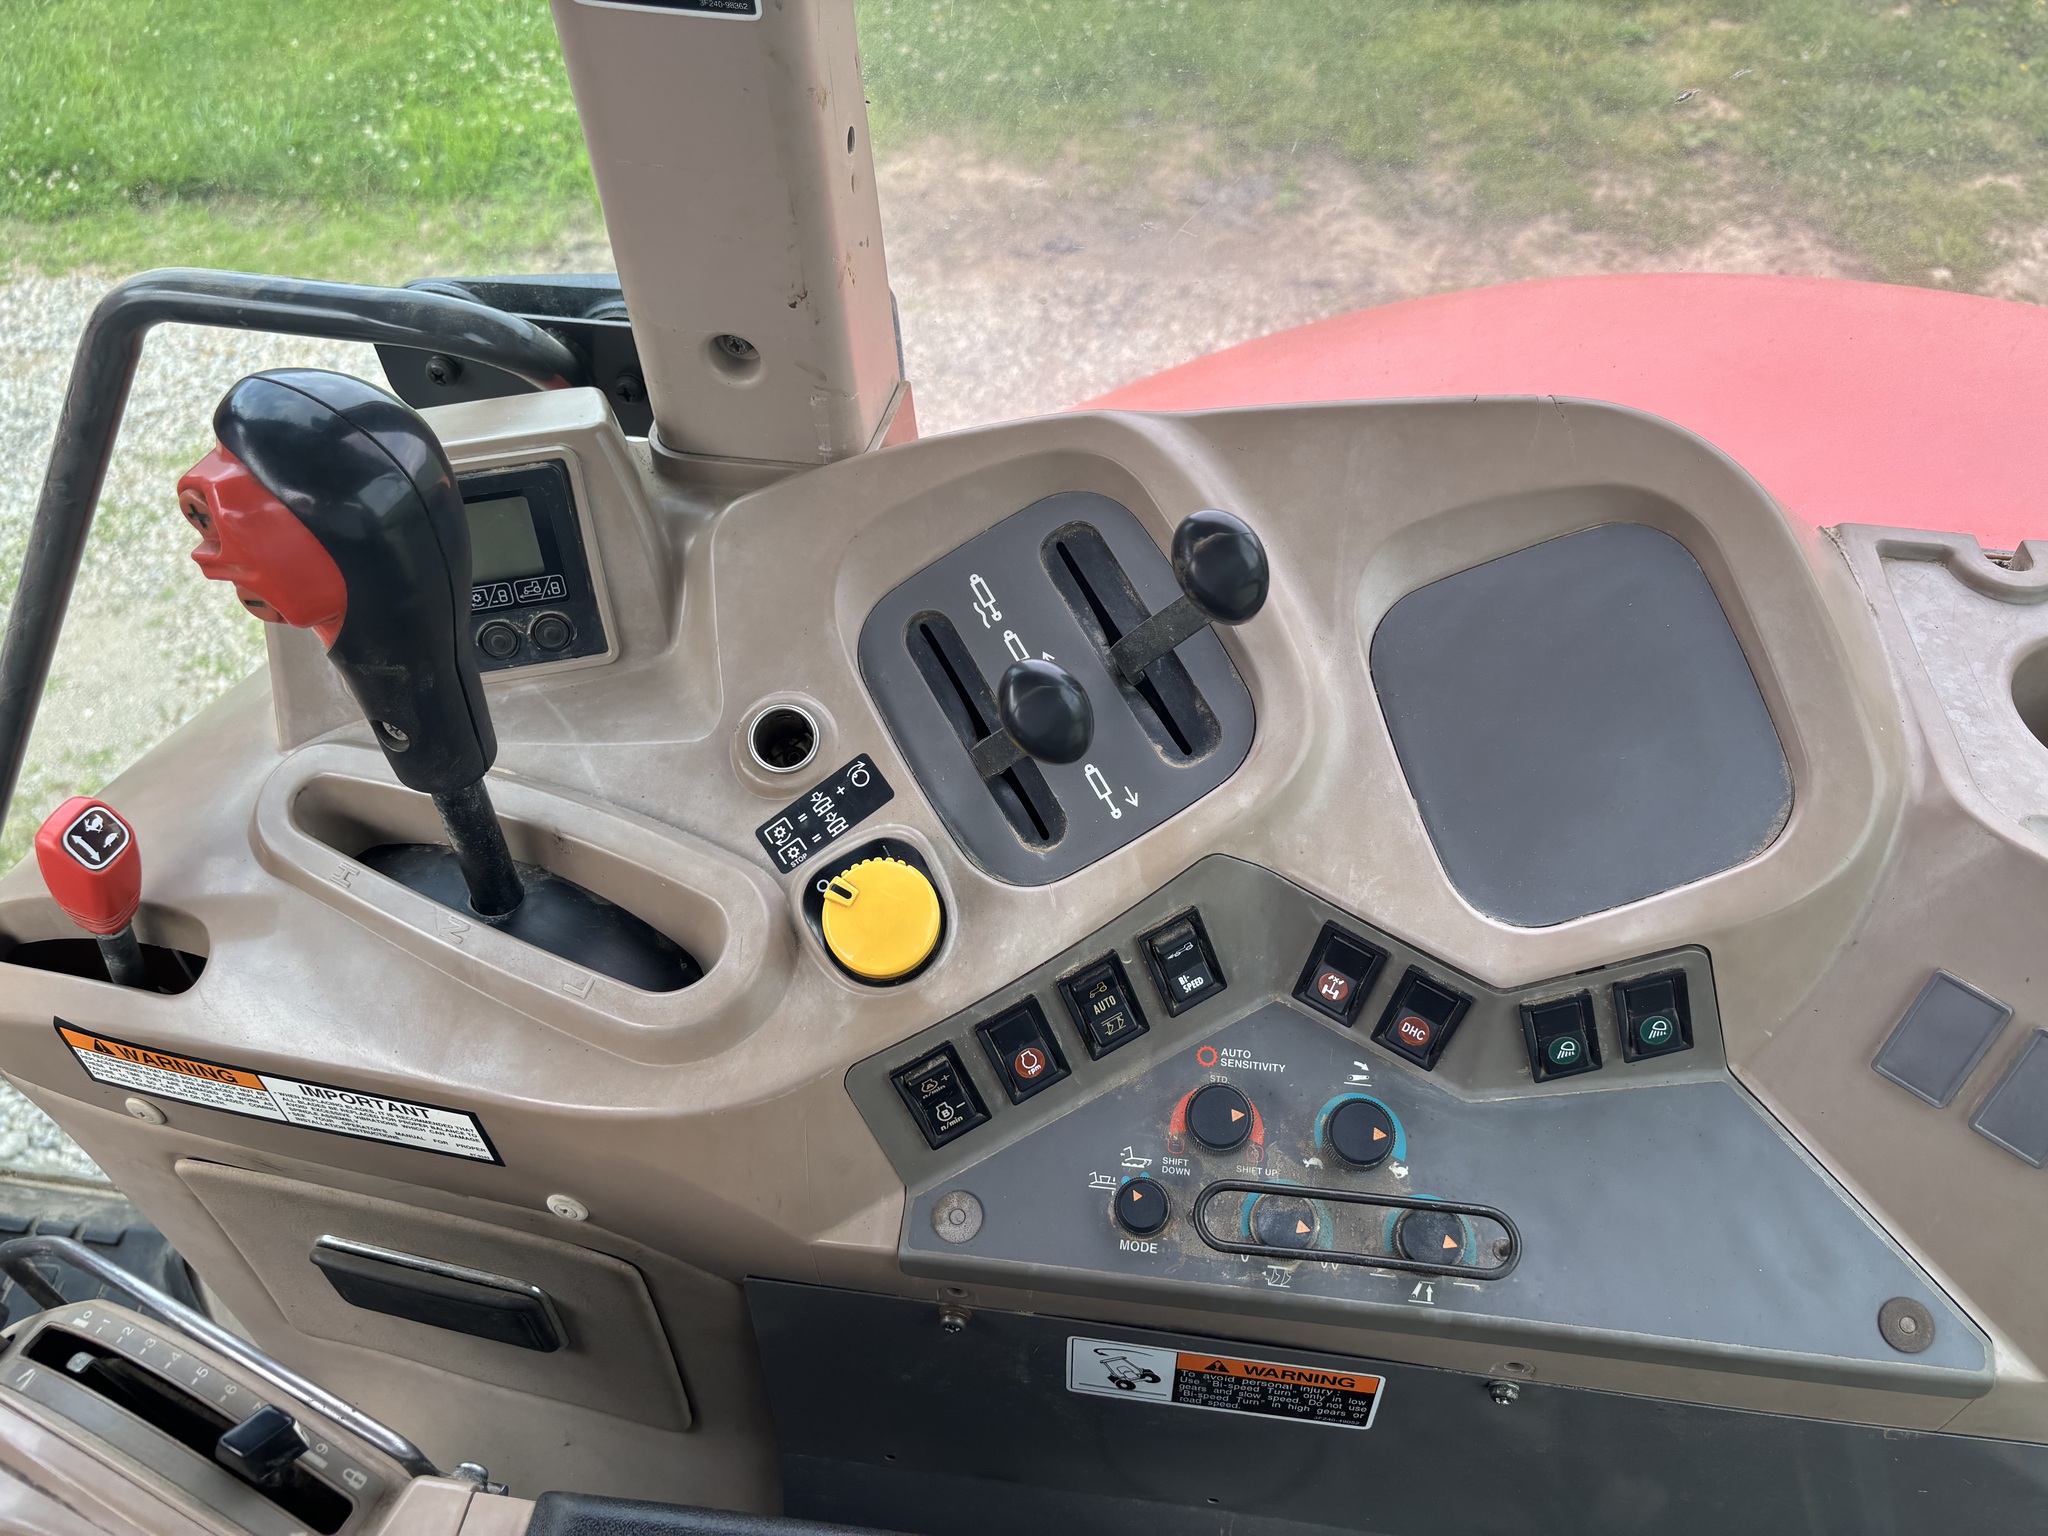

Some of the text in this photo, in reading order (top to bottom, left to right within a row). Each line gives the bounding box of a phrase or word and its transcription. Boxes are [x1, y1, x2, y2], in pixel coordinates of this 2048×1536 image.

[791, 853, 808, 868] STOP
[329, 861, 359, 889] H
[562, 974, 596, 999] L
[1178, 974, 1191, 988] BI-
[1183, 976, 1204, 994] SPEED
[1092, 994, 1117, 1016] AUTO
[1401, 1022, 1426, 1040] DHC
[1221, 1048, 1251, 1059] AUTO
[114, 1045, 238, 1083] WARNING
[1027, 1064, 1042, 1077] rpm
[1220, 1058, 1286, 1073] SENSITIVITY
[1210, 1075, 1230, 1084] STD.
[922, 1085, 946, 1099] n/min
[298, 1084, 429, 1119] IMPORTANT
[940, 1115, 964, 1131] n/min
[1162, 1156, 1189, 1167] SHIFT
[1162, 1165, 1190, 1176] DOWN
[1236, 1165, 1278, 1177] SHIFT UP
[1120, 1240, 1158, 1254] MODE
[122, 1326, 134, 1336] 2
[145, 1338, 157, 1348] 3
[172, 1351, 182, 1362] 4
[196, 1366, 208, 1378] 5
[1243, 1364, 1356, 1388] WARNING
[225, 1383, 237, 1395] 6
[1180, 1369, 1196, 1377] To
[1202, 1372, 1235, 1382] avoid
[1241, 1377, 1292, 1390] personal
[1300, 1385, 1333, 1396] injury
[1178, 1382, 1207, 1392] gears
[1213, 1386, 1232, 1395] and
[1237, 1390, 1261, 1399] slow
[1267, 1393, 1301, 1404] speed.
[1325, 1401, 1342, 1409] not
[1179, 1376, 1200, 1384] Use
[1302, 1392, 1325, 1401] only
[1348, 1397, 1367, 1406] low
[1179, 1395, 1241, 1409] road speed.
[1287, 1403, 1310, 1413] high
[1316, 1407, 1346, 1418] gears
[316, 1443, 328, 1454] 9
